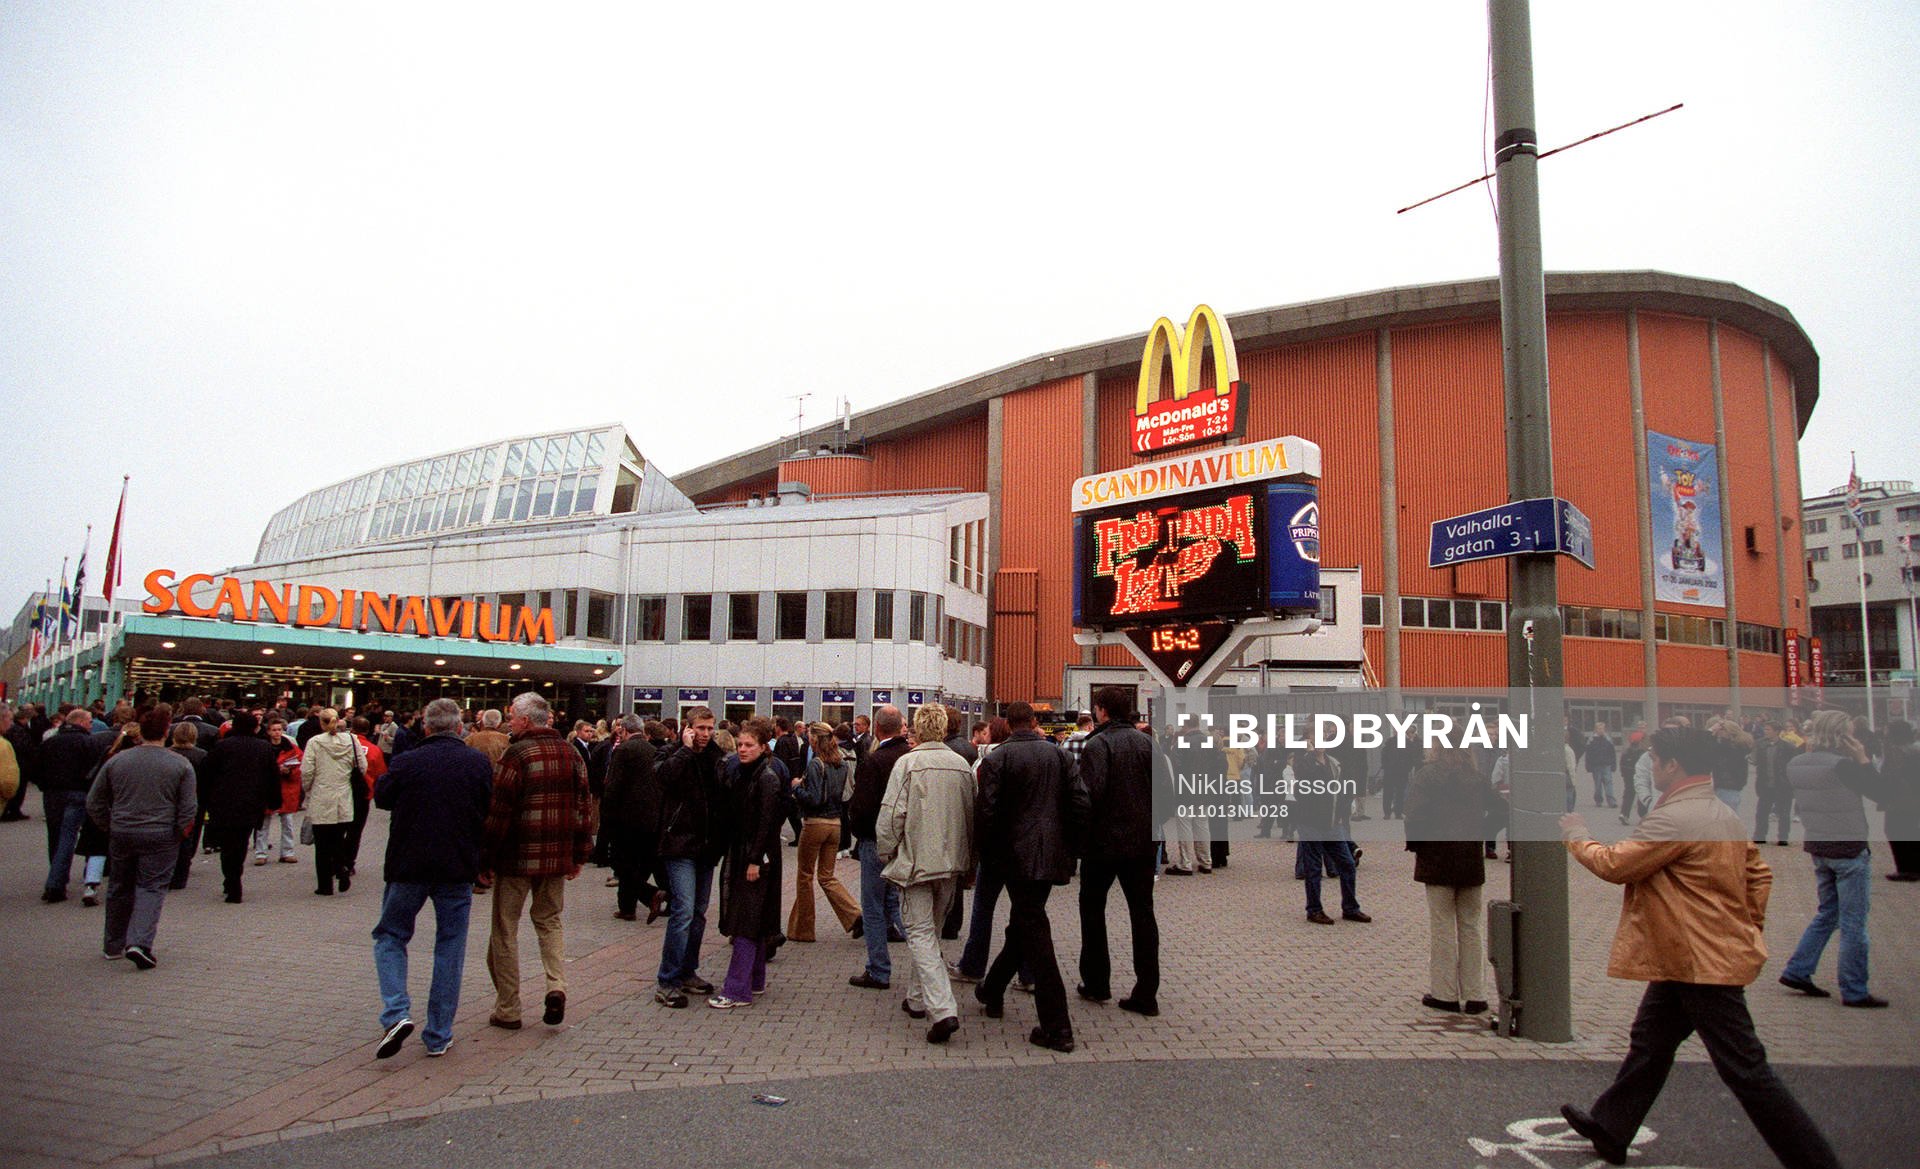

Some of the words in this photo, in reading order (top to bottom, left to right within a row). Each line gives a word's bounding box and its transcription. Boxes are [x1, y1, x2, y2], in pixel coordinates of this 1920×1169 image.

[1136, 398, 1229, 432] McDonald's
[1206, 414, 1228, 426] 7-24
[1202, 424, 1228, 437] 10-24
[1081, 443, 1288, 505] SCANDINAVIUM
[1444, 538, 1494, 561] gatan
[142, 569, 556, 645] SCANDINAVIUM
